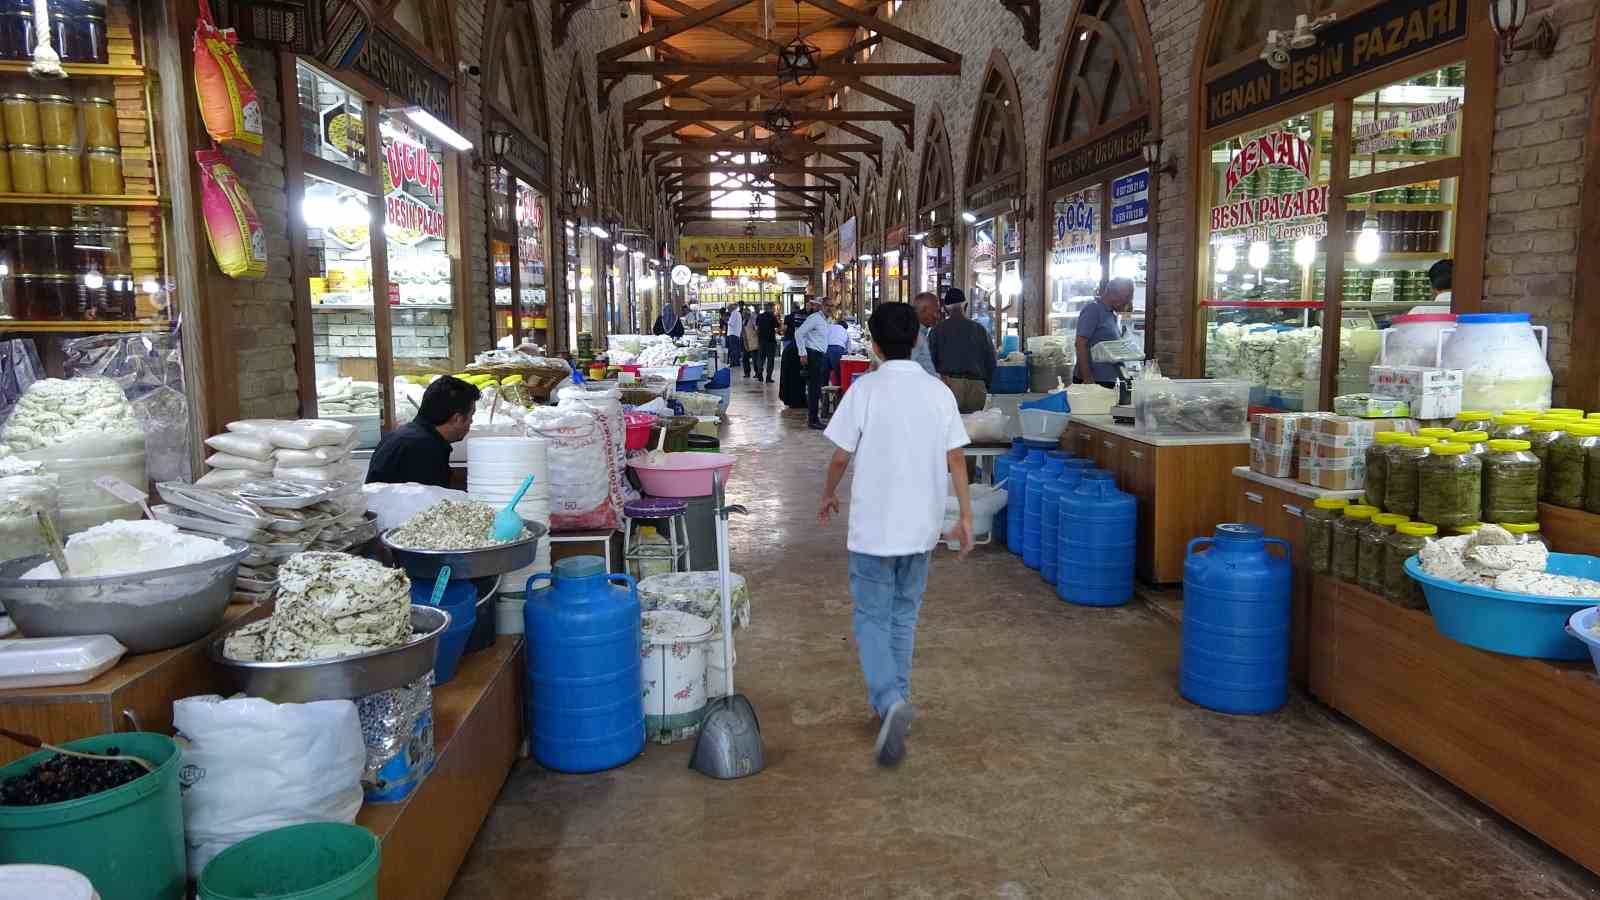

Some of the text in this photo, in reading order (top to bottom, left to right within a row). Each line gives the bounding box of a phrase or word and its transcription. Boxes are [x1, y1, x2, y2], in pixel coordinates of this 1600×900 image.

[1210, 1, 1458, 121] KENAN BESİN PAZARI
[1225, 131, 1312, 198] KENAN
[1211, 185, 1329, 231] BESİN PAZARI
[769, 243, 806, 253] PAZARI
